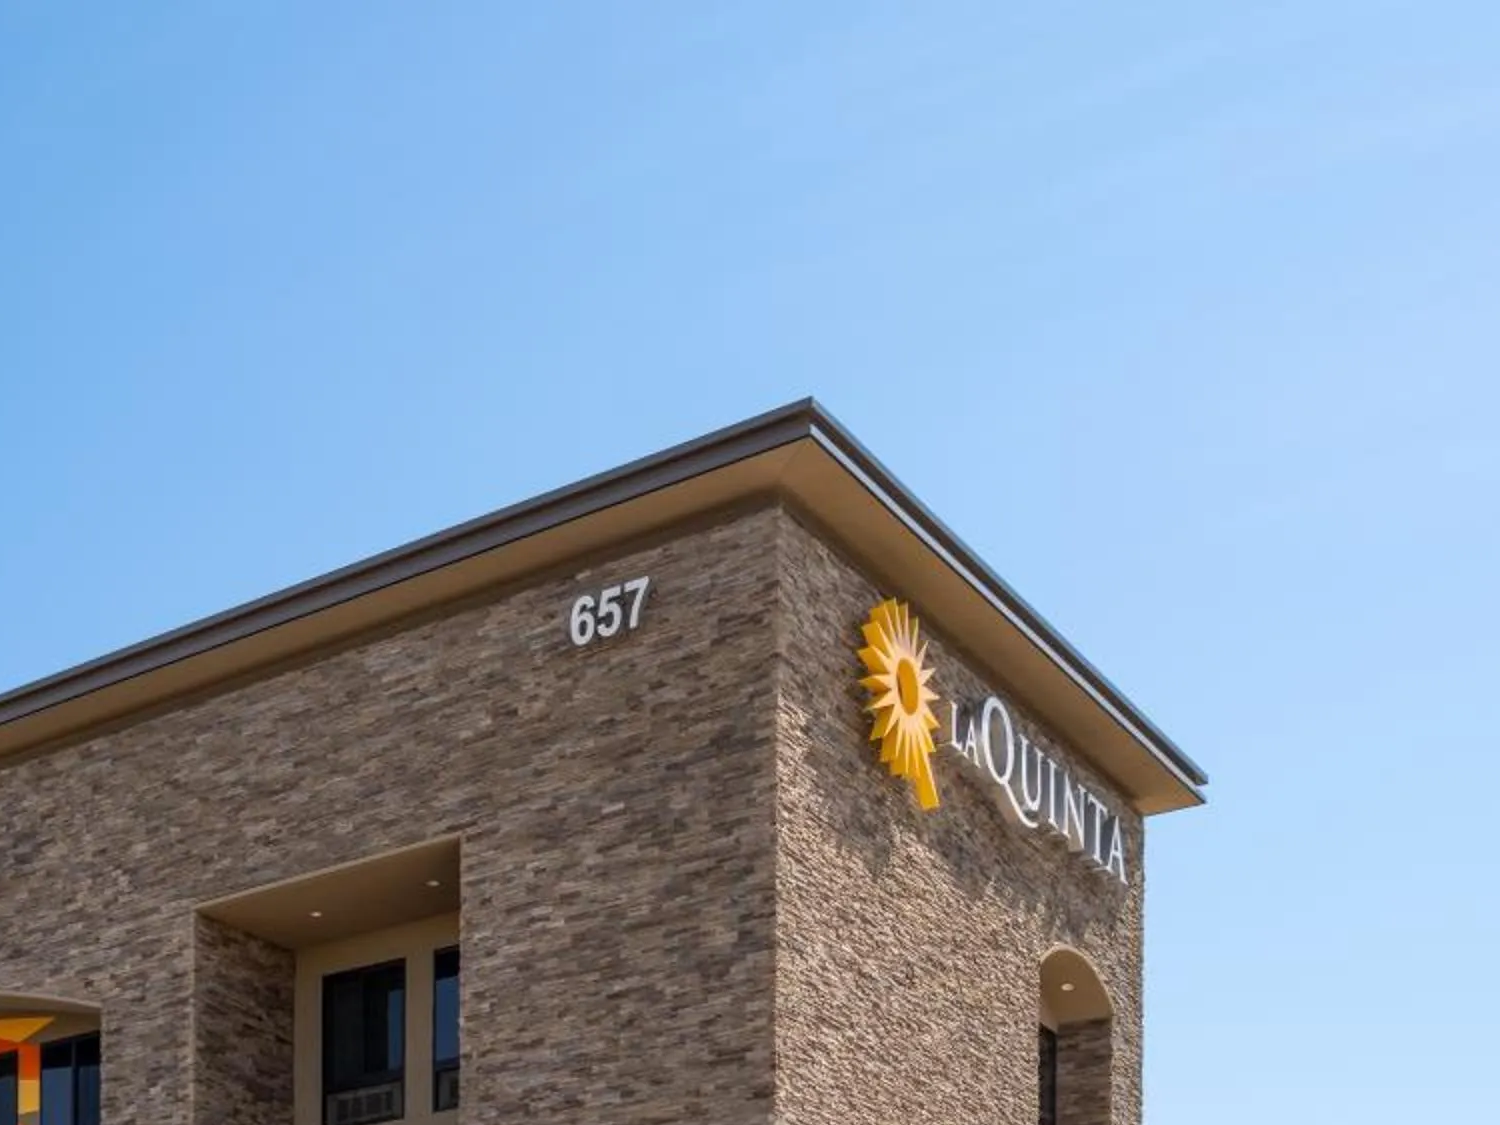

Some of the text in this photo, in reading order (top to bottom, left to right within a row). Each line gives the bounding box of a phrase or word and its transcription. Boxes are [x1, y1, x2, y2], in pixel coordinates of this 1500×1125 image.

[571, 575, 649, 646] 657
[950, 696, 1129, 885] LA QUINTA
